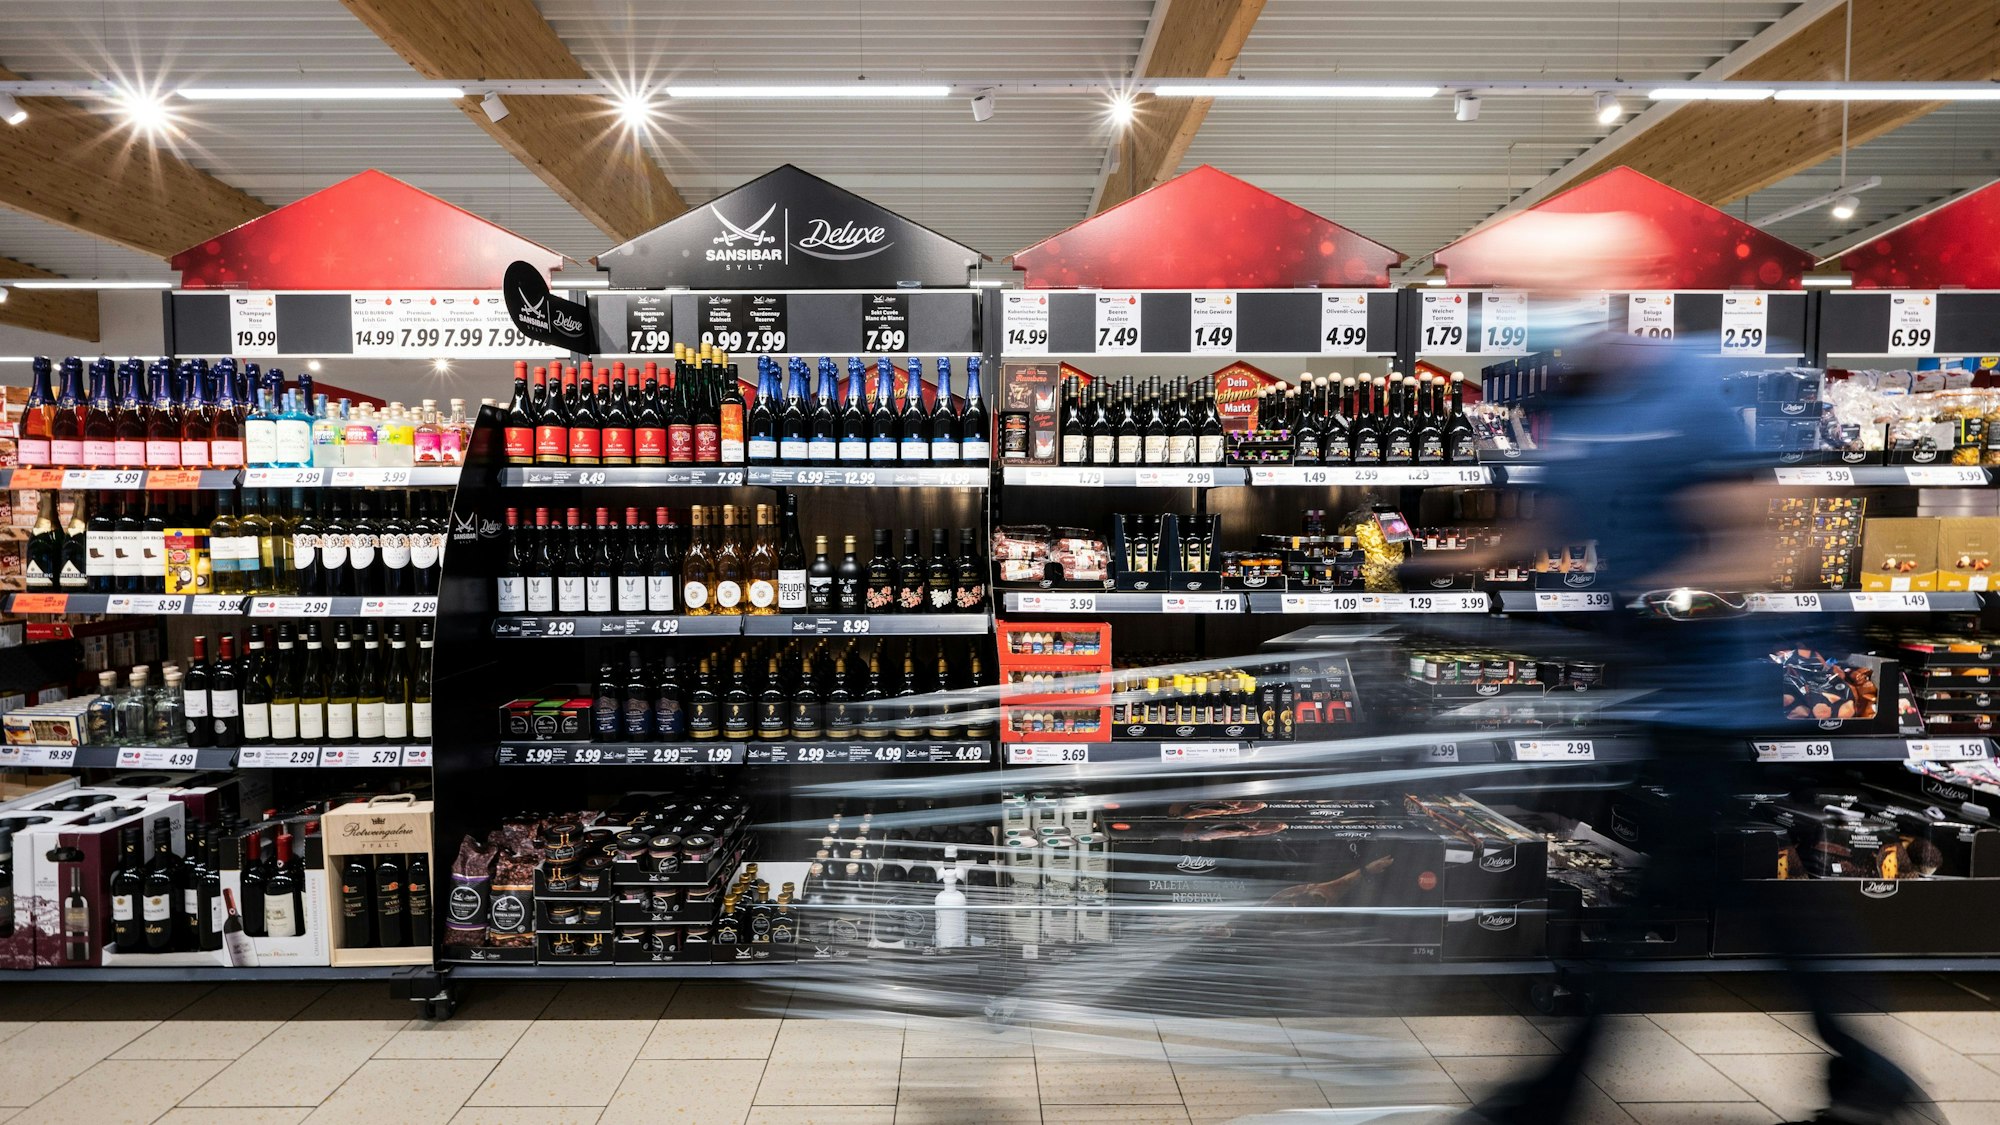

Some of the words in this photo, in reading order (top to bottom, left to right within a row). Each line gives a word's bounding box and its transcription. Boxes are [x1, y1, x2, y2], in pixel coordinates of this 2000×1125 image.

[800, 218, 885, 250] Deluxe
[706, 249, 782, 261] SANSIBAR
[519, 314, 548, 329] SANSIBAR
[553, 310, 583, 331] Deluxe
[237, 331, 276, 346] 19.99
[356, 331, 395, 345] 14.99
[401, 328, 440, 347] 7.99
[444, 328, 482, 347] 7.99
[488, 328, 526, 347] 7.99
[631, 331, 670, 351] 7.99
[701, 332, 742, 350] 9.99
[866, 330, 905, 350] 7.99
[1008, 329, 1047, 344] 14.99
[1099, 328, 1138, 346] 7.49
[1195, 327, 1232, 345] 1.49
[1326, 327, 1366, 345] 4.99
[1426, 326, 1462, 345] 1.79
[1488, 327, 1525, 346] 1.99
[1724, 328, 1762, 347] 2.59
[1892, 329, 1931, 346] 6.99
[747, 332, 785, 351] 7.99
[1227, 378, 1247, 386] Dein
[1015, 387, 1023, 400] 7
[1225, 404, 1251, 412] Markt
[114, 473, 138, 484] 5.99
[296, 473, 320, 483] 2.99
[383, 472, 406, 483] 3.99
[579, 473, 606, 484] 8.49
[718, 472, 743, 484] 7.99
[797, 471, 824, 484] 6.99
[845, 471, 876, 484] 12.99
[1078, 472, 1101, 484] 1.79
[1187, 473, 1211, 484] 2.99
[1304, 473, 1326, 483] 1.49
[1355, 471, 1378, 480] 2.99
[1458, 471, 1480, 482] 1.19
[1827, 470, 1849, 481] 3.99
[1958, 470, 1981, 481] 3.99
[780, 583, 806, 591] REUDEN
[783, 592, 800, 600] FEST
[1586, 594, 1610, 605] 3.99
[1794, 596, 1817, 606] 1.99
[1902, 595, 1925, 606] 1.49
[158, 600, 181, 611] 8.99
[218, 600, 240, 611] 9.99
[304, 603, 328, 613] 2.99
[412, 603, 436, 613] 2.99
[1070, 599, 1093, 609] 3.99
[1216, 599, 1237, 610] 1.19
[1334, 599, 1357, 609] 1.09
[1410, 598, 1432, 609] 1.29
[1462, 598, 1484, 609] 3.99
[548, 622, 575, 635] 2.99
[651, 620, 678, 633] 4.99
[843, 620, 869, 633] 8.99
[956, 747, 982, 760] 4.49
[1431, 745, 1454, 756] 2.99
[1567, 743, 1591, 754] 2.99
[1806, 745, 1829, 755] 6.99
[1959, 745, 1982, 756] 1.59
[48, 750, 72, 760] 19.99
[169, 754, 193, 765] 4.99
[290, 752, 314, 763] 2.99
[372, 752, 397, 763] 5.79
[526, 749, 552, 761] 5.99
[574, 749, 601, 762] 5.99
[653, 749, 679, 762] 2.99
[707, 749, 731, 761] 1.99
[797, 748, 824, 761] 2.99
[875, 748, 901, 761] 4.99
[1062, 750, 1085, 761] 3.69
[1928, 781, 1968, 800] Deluxe
[343, 823, 413, 839] Rotweingalerie
[1177, 855, 1215, 869] Deluxe
[1483, 857, 1512, 867] Deluxe
[1149, 881, 1189, 889] PALETA
[1865, 882, 1894, 892] Deluxe
[1172, 893, 1222, 902] RESERVA
[1483, 916, 1512, 925] Deluxe
